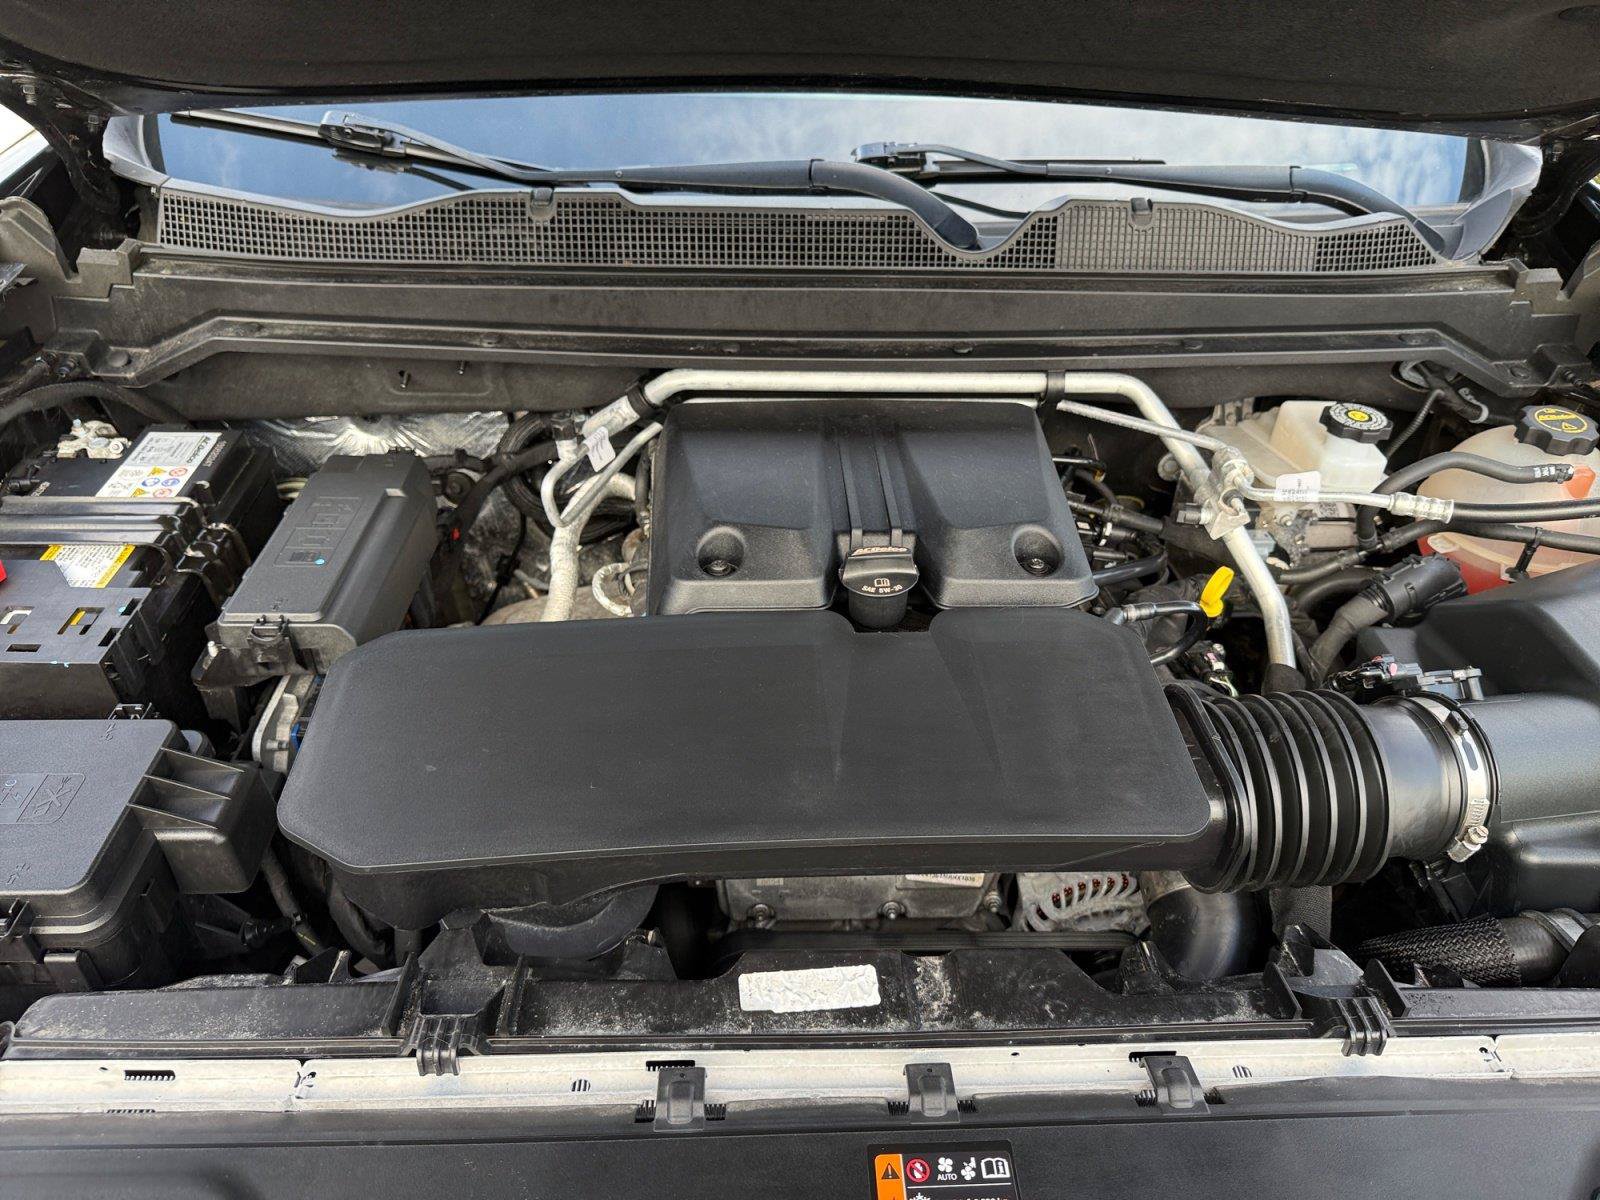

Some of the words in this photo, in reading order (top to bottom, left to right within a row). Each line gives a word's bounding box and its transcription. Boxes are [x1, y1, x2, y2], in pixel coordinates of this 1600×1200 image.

[851, 546, 908, 556] ACDelco
[862, 585, 876, 593] SAE
[879, 584, 903, 594] 5W-30
[937, 1173, 957, 1181] AUTO
